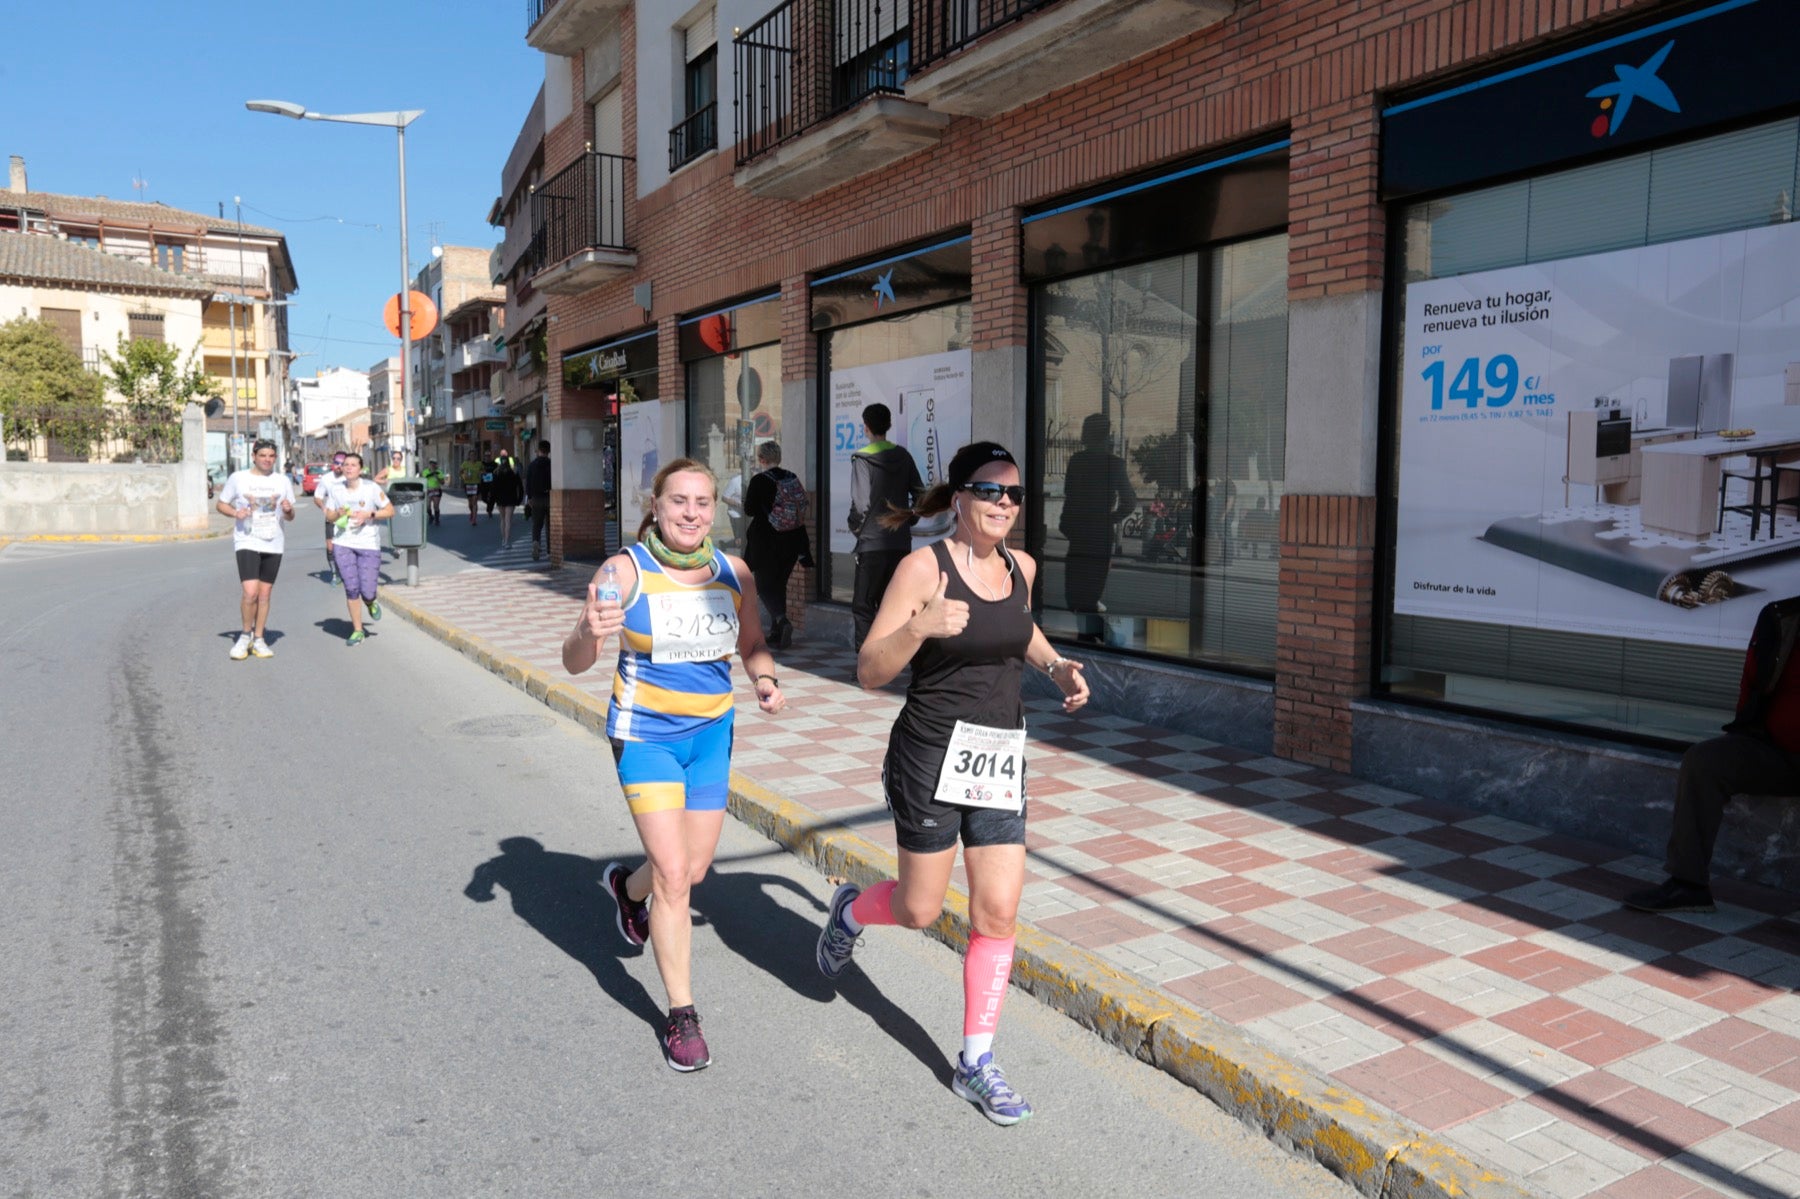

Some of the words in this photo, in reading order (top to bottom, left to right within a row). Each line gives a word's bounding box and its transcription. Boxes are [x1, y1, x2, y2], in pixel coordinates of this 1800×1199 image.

[1424, 299, 1482, 317] Renueva
[1486, 296, 1501, 309] tu
[1505, 290, 1552, 307] hogar,
[1423, 317, 1477, 333] renueva
[1481, 314, 1496, 326] tu
[1501, 306, 1549, 324] ilusión
[599, 349, 627, 371] CaixaBank
[1422, 345, 1442, 358] por
[1421, 354, 1519, 410] 149
[926, 398, 935, 422] 5G
[1523, 393, 1555, 405] mes
[1413, 581, 1450, 592] Disfrutar
[1452, 584, 1464, 593] de
[1466, 585, 1474, 594] la
[1476, 586, 1496, 596] vida
[954, 749, 1015, 780] 3014
